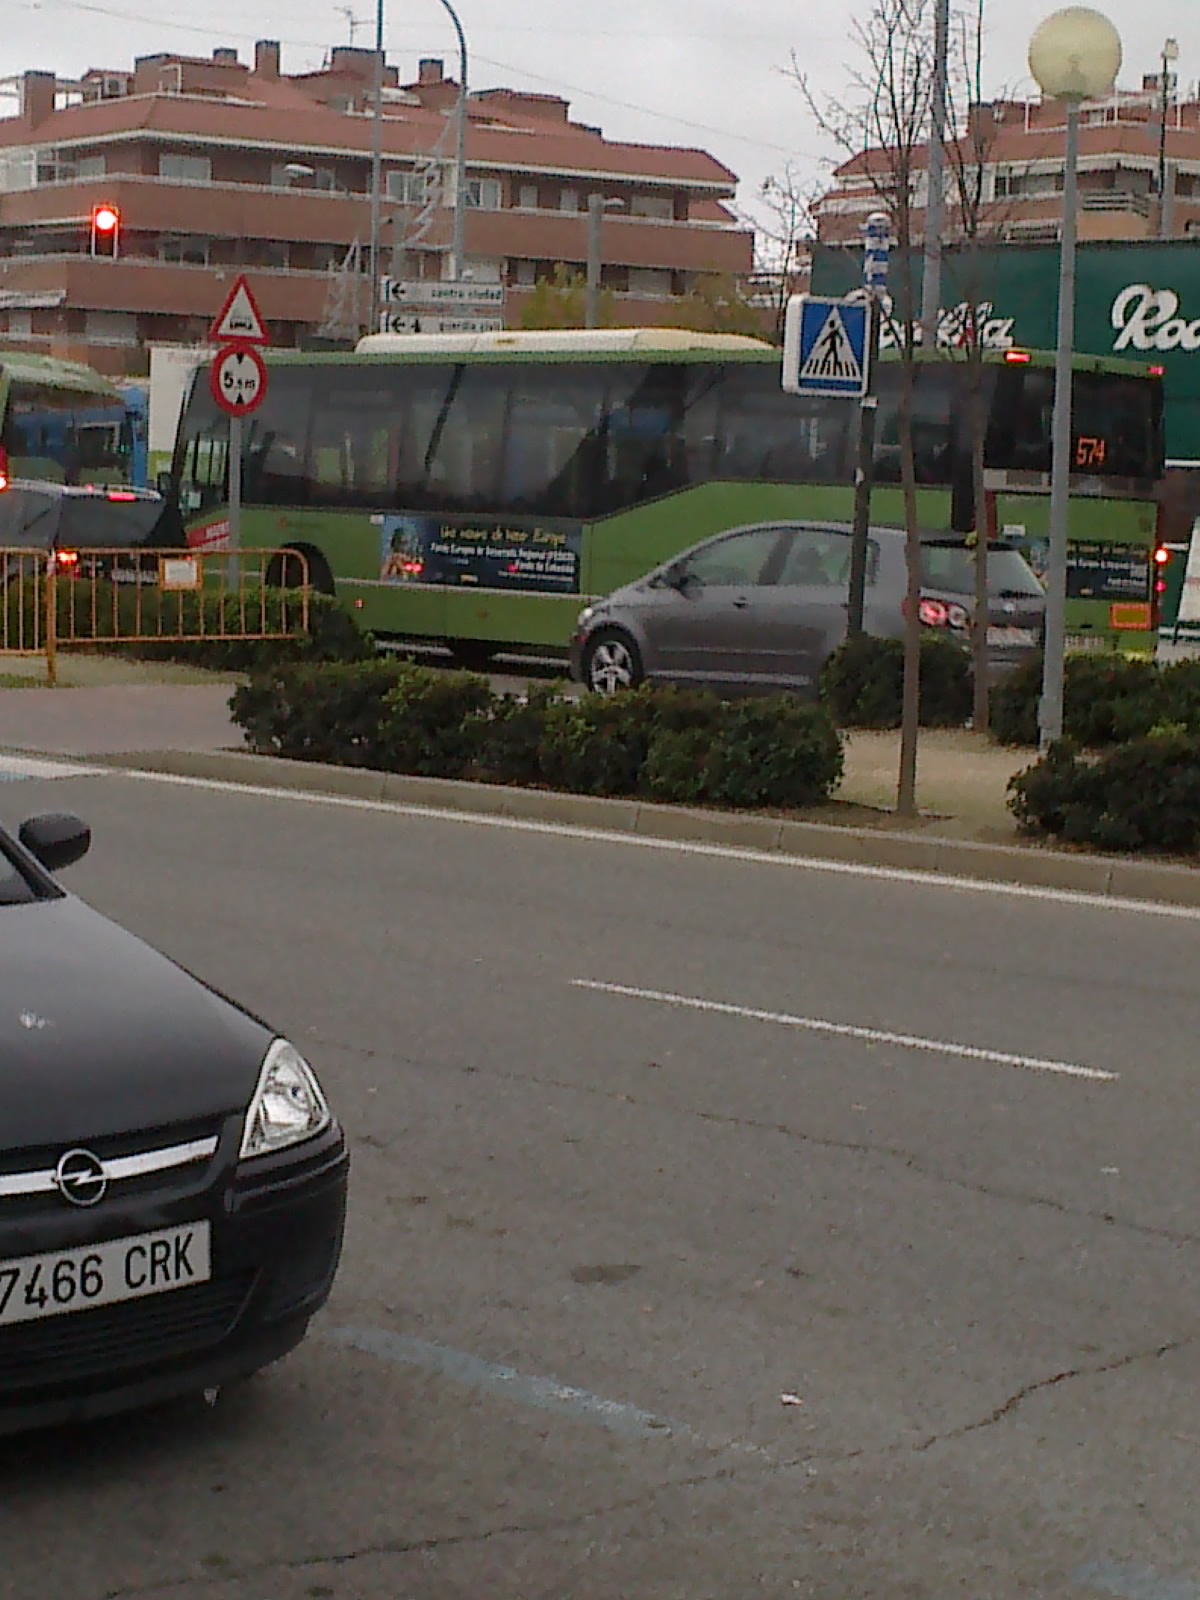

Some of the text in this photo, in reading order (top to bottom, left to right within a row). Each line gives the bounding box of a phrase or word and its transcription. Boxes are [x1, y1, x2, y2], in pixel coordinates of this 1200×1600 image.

[1076, 437, 1105, 465] 574
[0, 1232, 194, 1314] 7466 CRK
